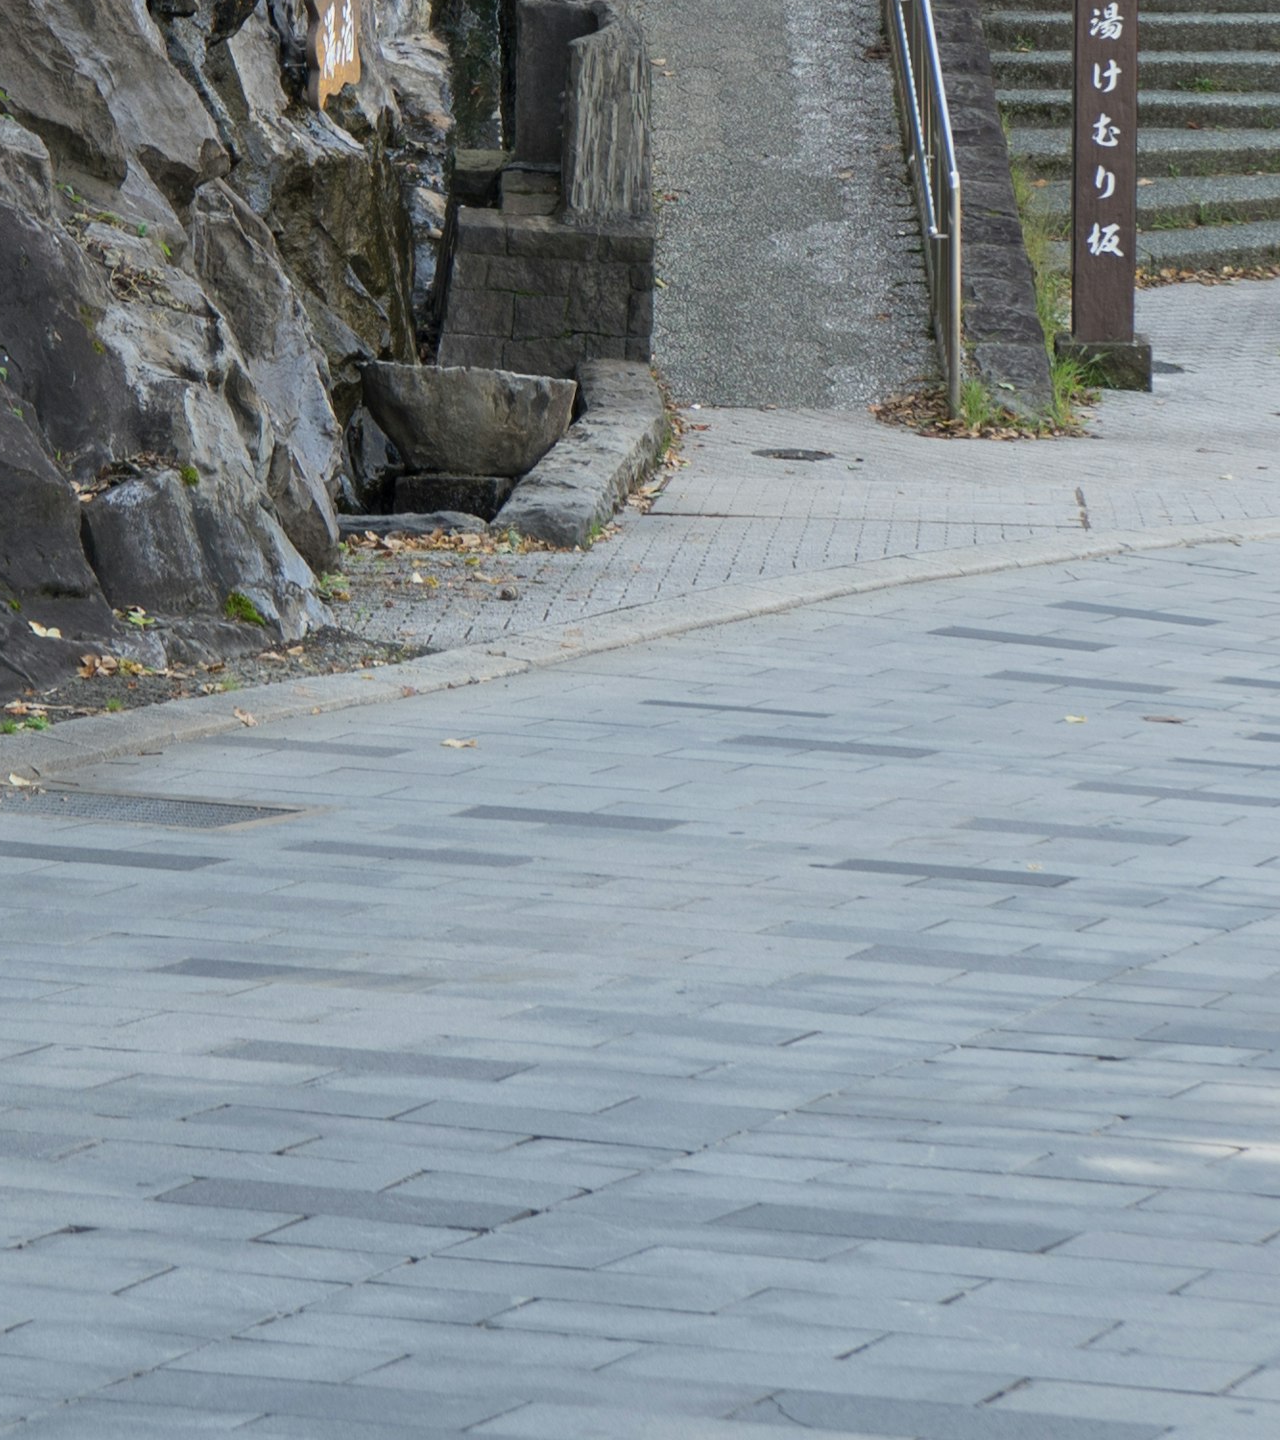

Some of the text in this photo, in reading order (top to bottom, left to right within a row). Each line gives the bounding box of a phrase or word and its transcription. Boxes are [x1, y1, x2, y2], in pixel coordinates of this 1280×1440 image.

[1087, 1, 1125, 258] 湯けむり坂
